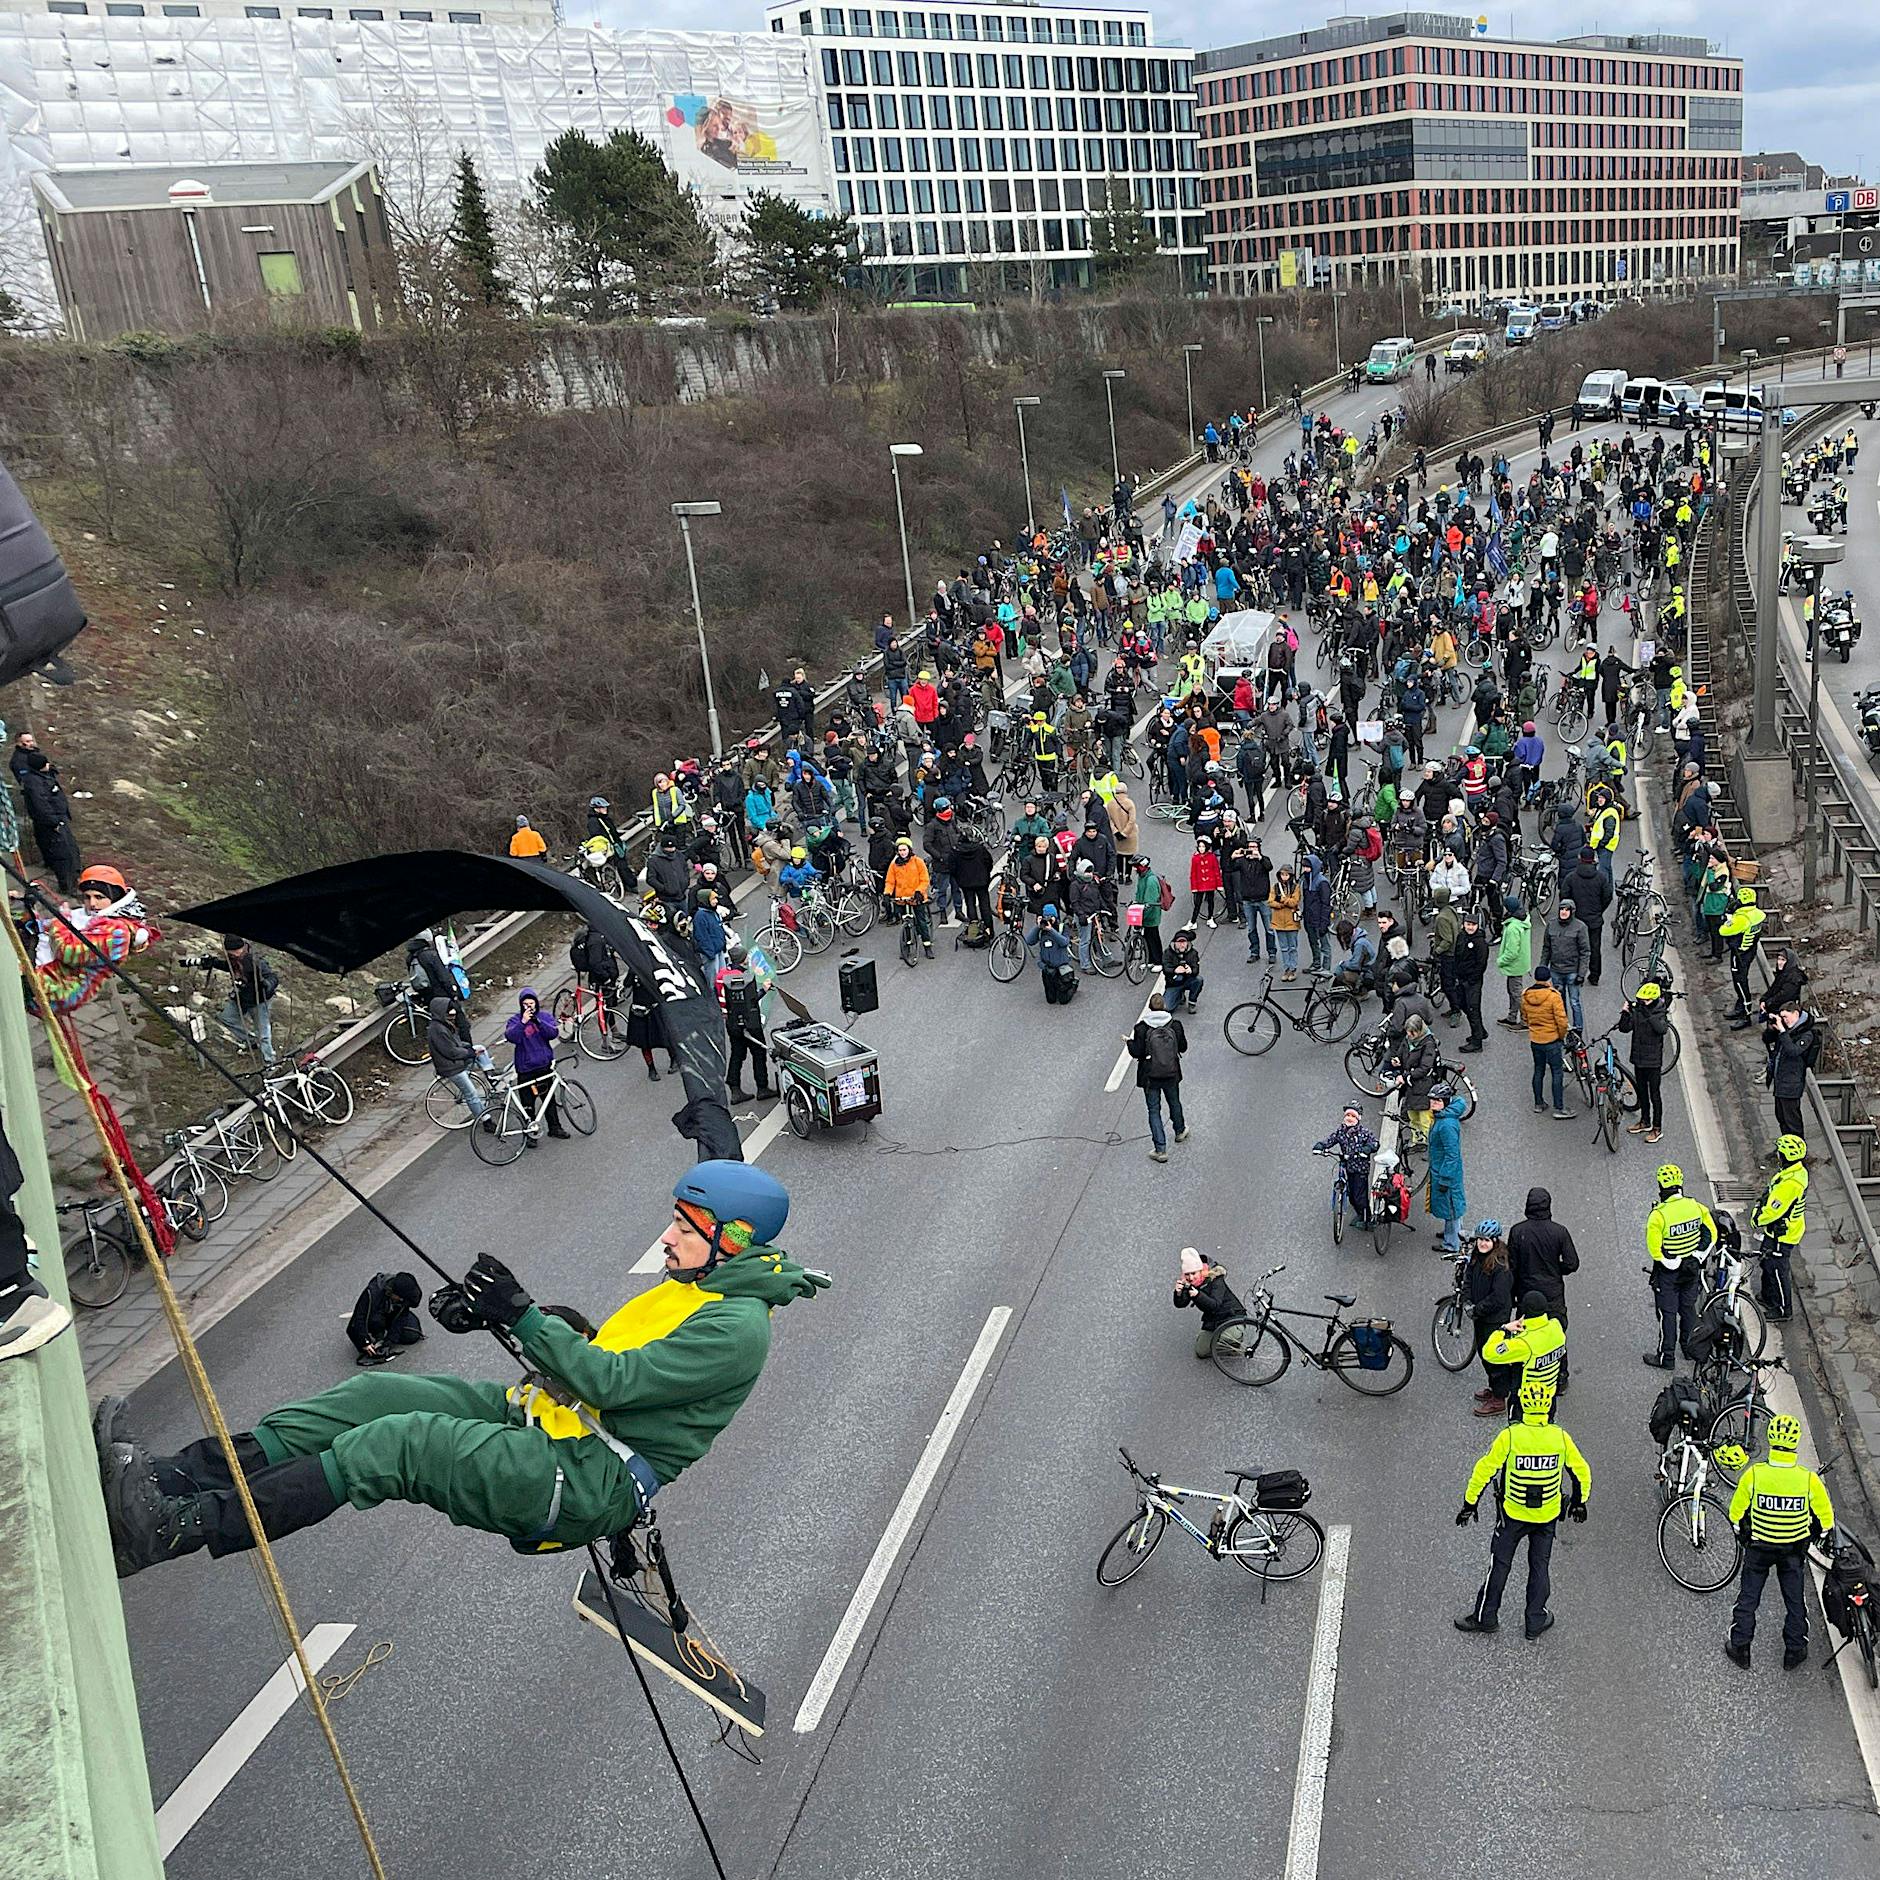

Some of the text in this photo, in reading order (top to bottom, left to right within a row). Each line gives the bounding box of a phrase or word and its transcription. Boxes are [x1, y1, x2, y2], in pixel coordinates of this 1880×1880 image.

[1834, 198, 1843, 211] P
[1856, 192, 1875, 206] DB
[1758, 1495, 1804, 1510] POLIZEI
